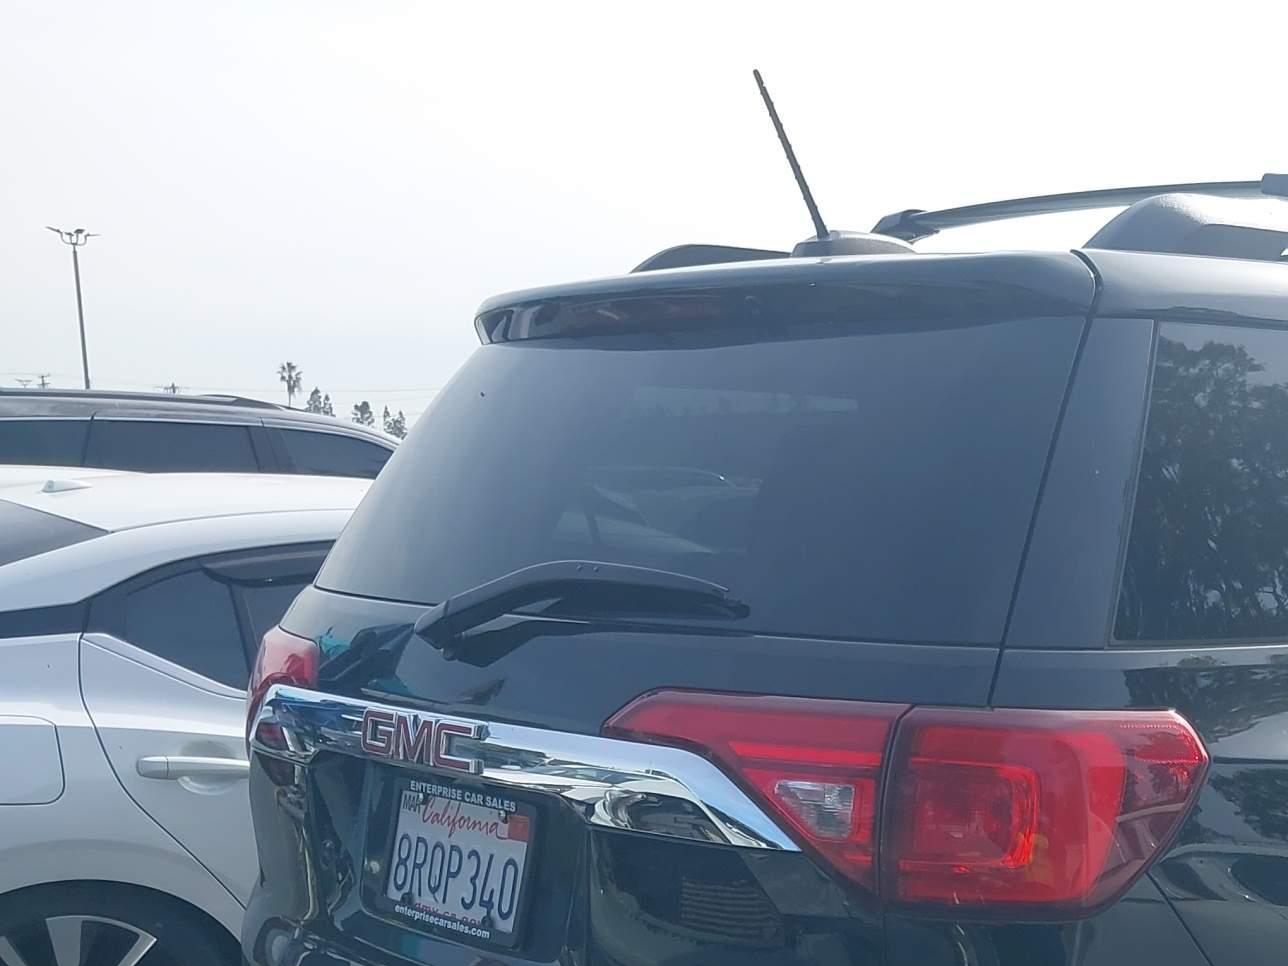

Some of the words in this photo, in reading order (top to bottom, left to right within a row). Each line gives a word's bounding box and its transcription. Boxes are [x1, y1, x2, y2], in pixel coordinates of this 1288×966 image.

[361, 705, 488, 775] GMC
[410, 780, 463, 801] ENTERPRISE
[464, 791, 485, 805] CAR
[485, 795, 517, 813] SALES
[421, 796, 509, 839] California
[392, 833, 520, 922] 8RQP340
[394, 903, 491, 939] enterprisecarsales.com
